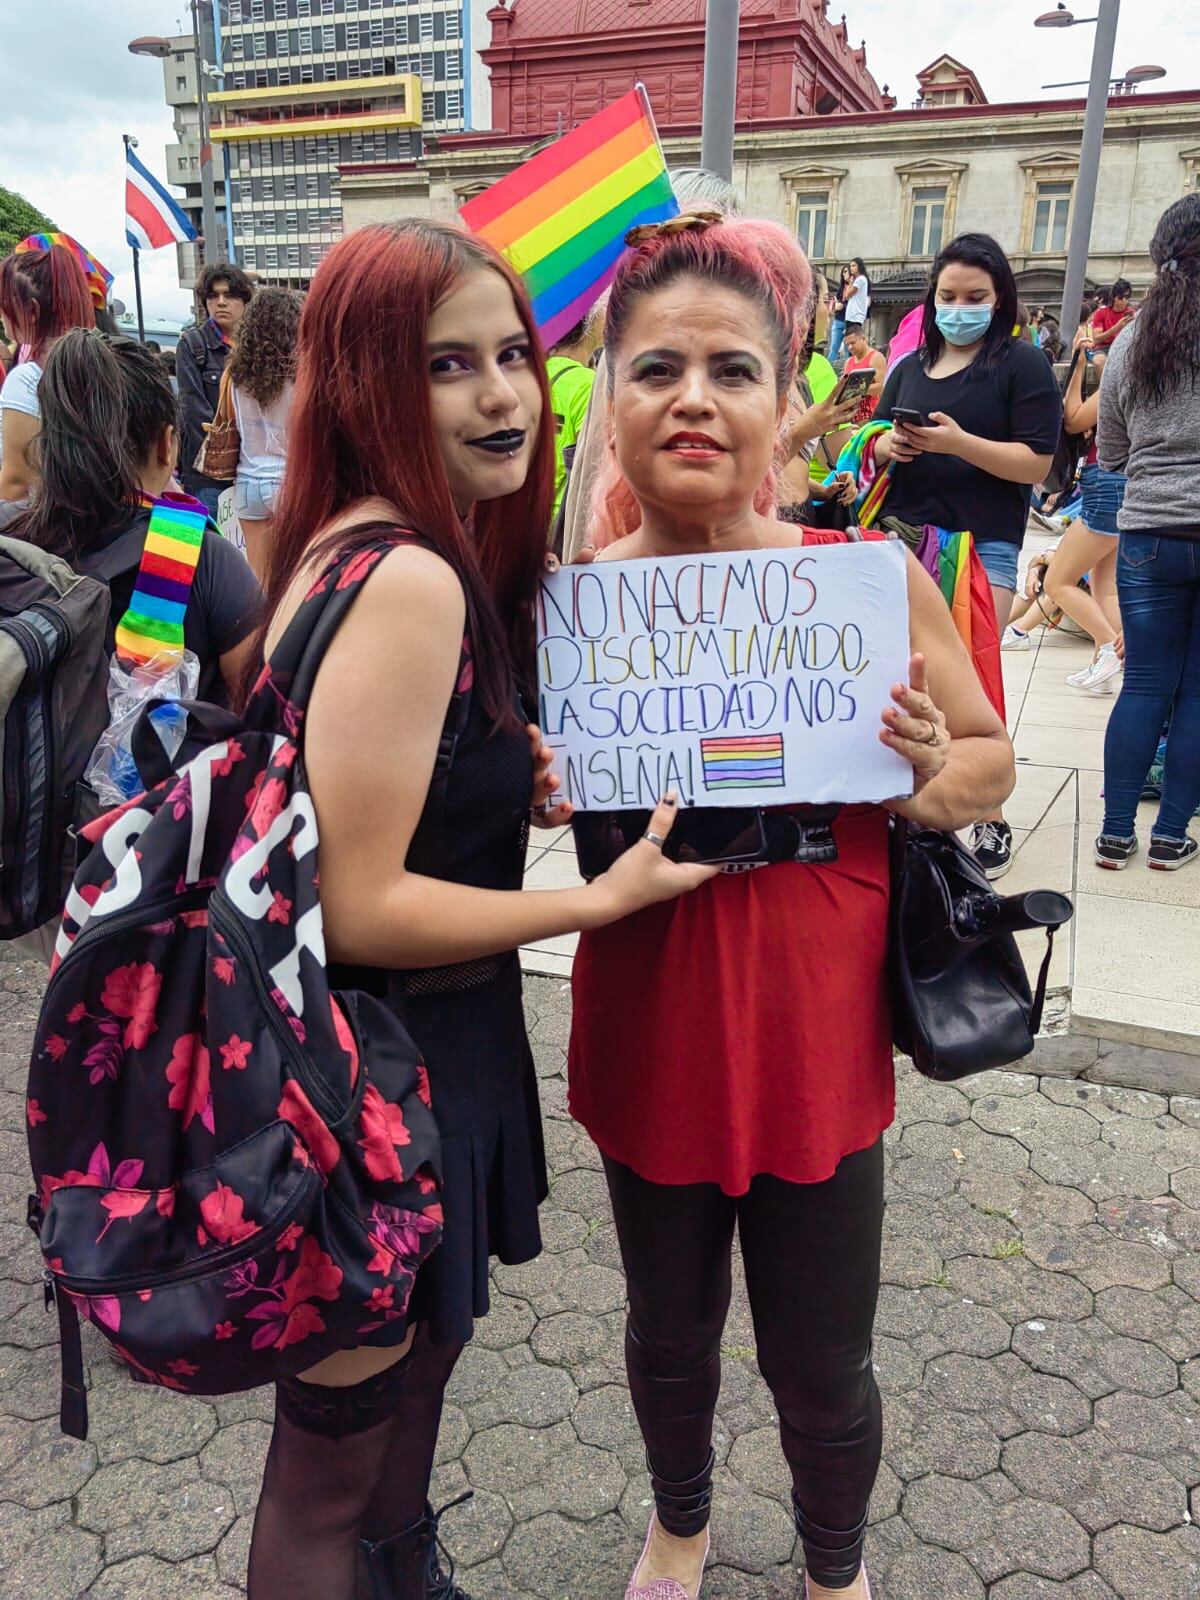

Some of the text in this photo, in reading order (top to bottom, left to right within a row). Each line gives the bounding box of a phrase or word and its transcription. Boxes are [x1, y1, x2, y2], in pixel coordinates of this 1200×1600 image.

[539, 557, 818, 639] NO NACEMOS
[537, 622, 870, 692] DISCRIMINANDO,
[540, 676, 857, 739] LA SOCIEDAD NOS
